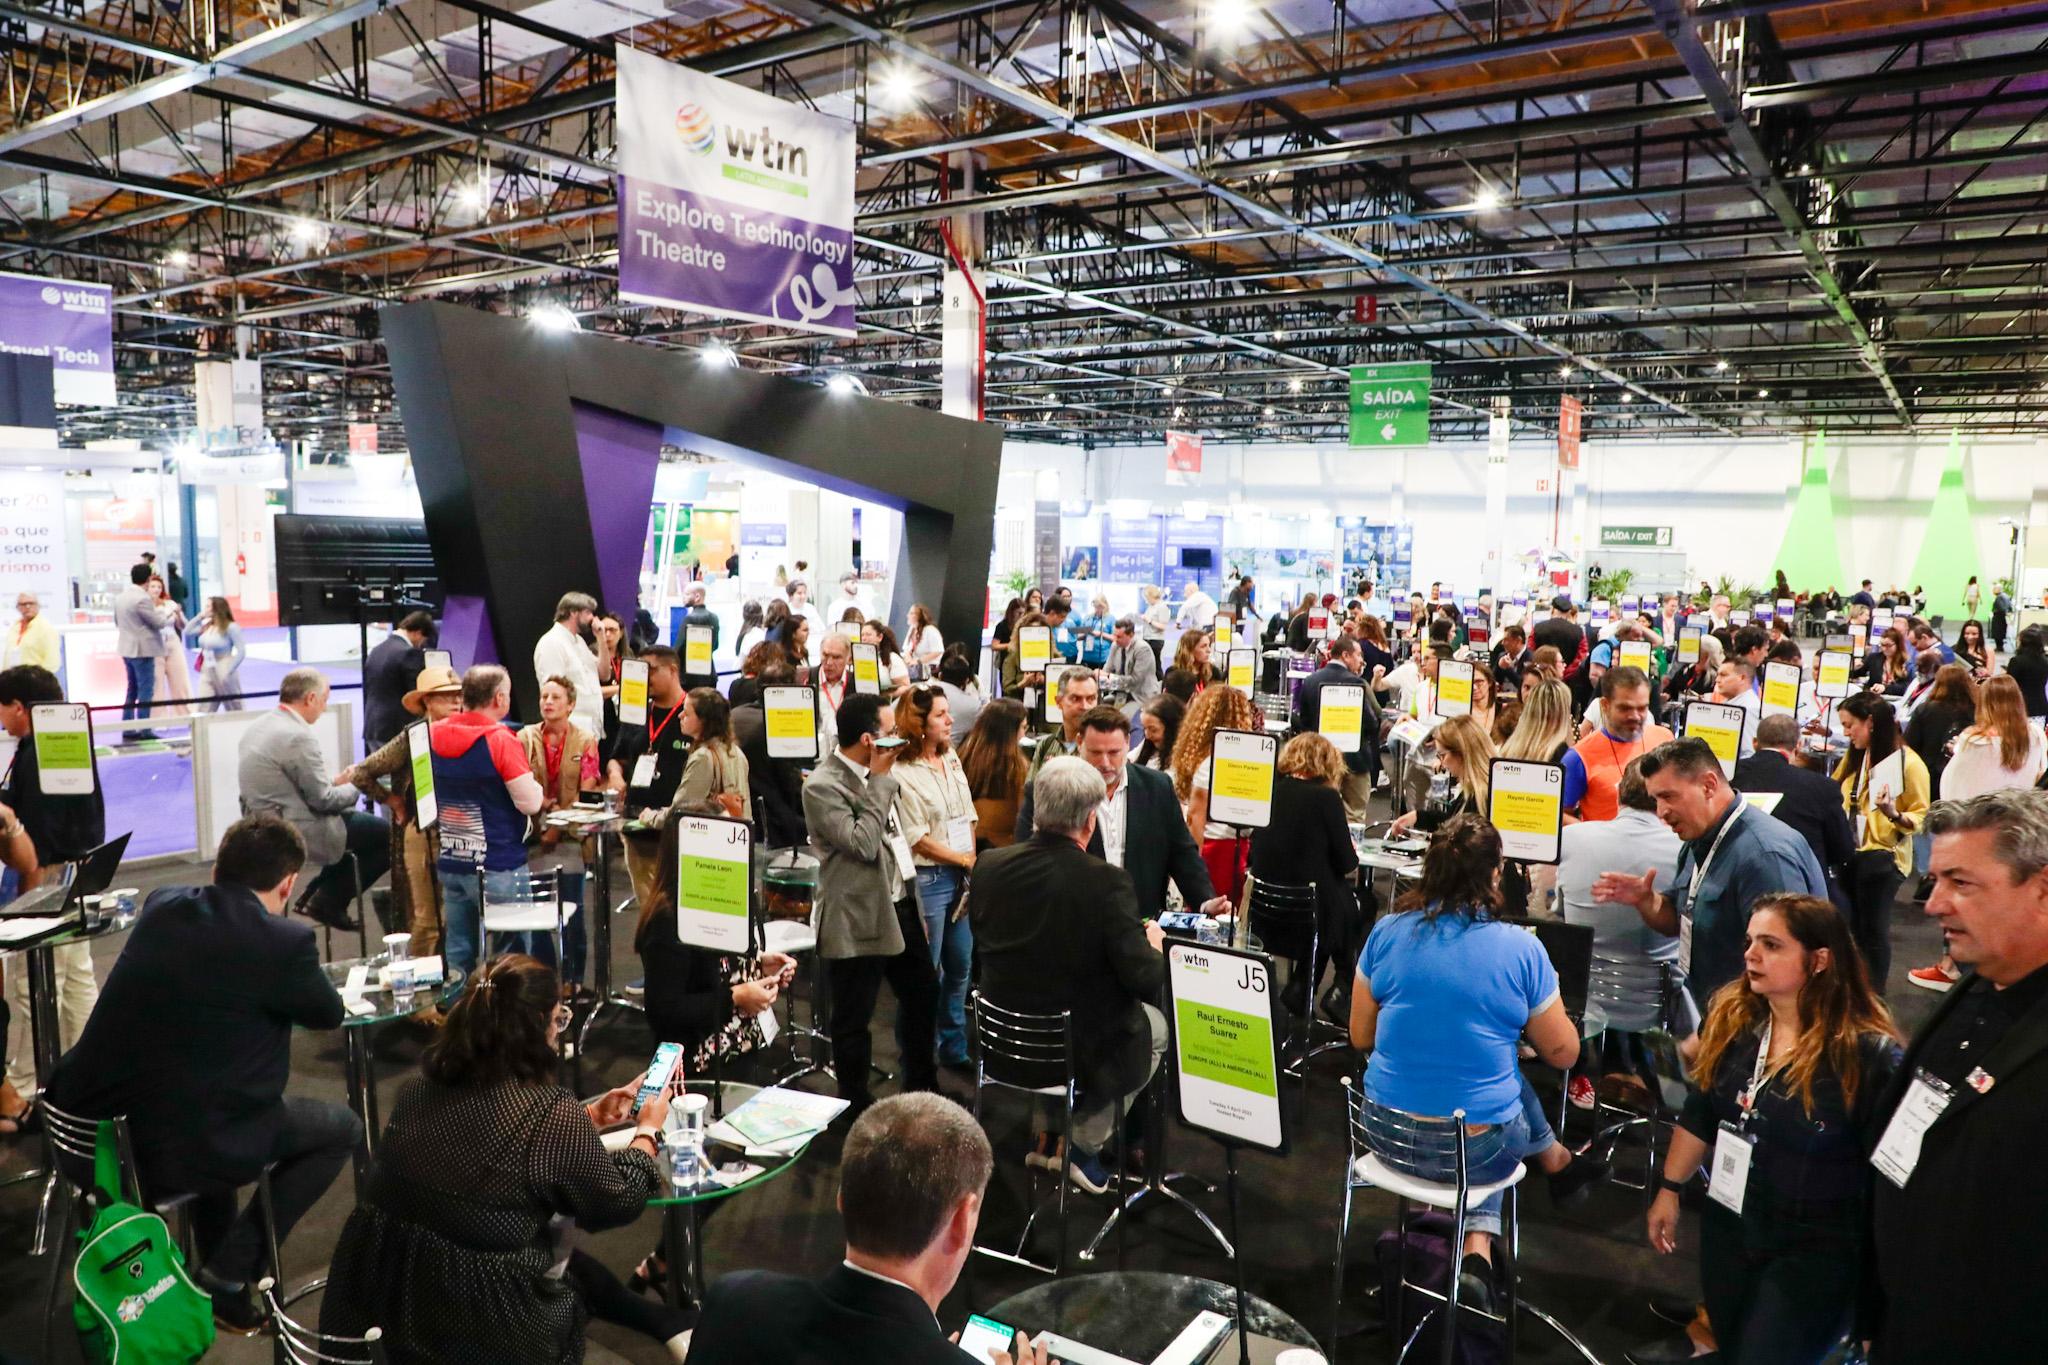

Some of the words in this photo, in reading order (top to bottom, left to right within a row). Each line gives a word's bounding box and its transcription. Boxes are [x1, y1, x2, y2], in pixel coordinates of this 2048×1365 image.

[724, 124, 808, 177] wtm
[636, 190, 725, 233] Explore
[730, 212, 847, 265] Technology
[636, 229, 726, 271] Theatre
[63, 291, 106, 307] wtm
[953, 296, 959, 308] 8
[54, 346, 99, 365] Tech
[1363, 387, 1416, 405] SAÍDA
[1375, 409, 1402, 420] EXIT
[15, 525, 49, 538] que
[1604, 529, 1630, 541] SAÍDA
[1637, 532, 1653, 541] EXIT
[4, 542, 50, 554] setor
[0, 560, 51, 573] rismo
[1460, 663, 1472, 672] G4
[1786, 667, 1799, 678] G5
[801, 689, 813, 700] I3
[1348, 689, 1362, 698] H4
[71, 707, 86, 721] J2
[1722, 708, 1741, 721] H5
[1261, 738, 1274, 752] I4
[1503, 765, 1521, 773] wtm
[1545, 768, 1559, 783] I5
[690, 822, 708, 831] wtm
[727, 826, 748, 846] J4
[695, 860, 716, 871] Pamela
[717, 864, 733, 873] Leon
[1184, 953, 1209, 967] wtm
[1237, 963, 1266, 993] J5
[1197, 1010, 1215, 1023] Raul
[1217, 1015, 1249, 1031] Ernesto
[1209, 1025, 1238, 1040] Suarez
[1188, 1053, 1207, 1064] EUROPE
[1208, 1059, 1221, 1068] (ALL)
[1226, 1064, 1253, 1076] AMERICAS
[1253, 1071, 1267, 1080] (ALL)
